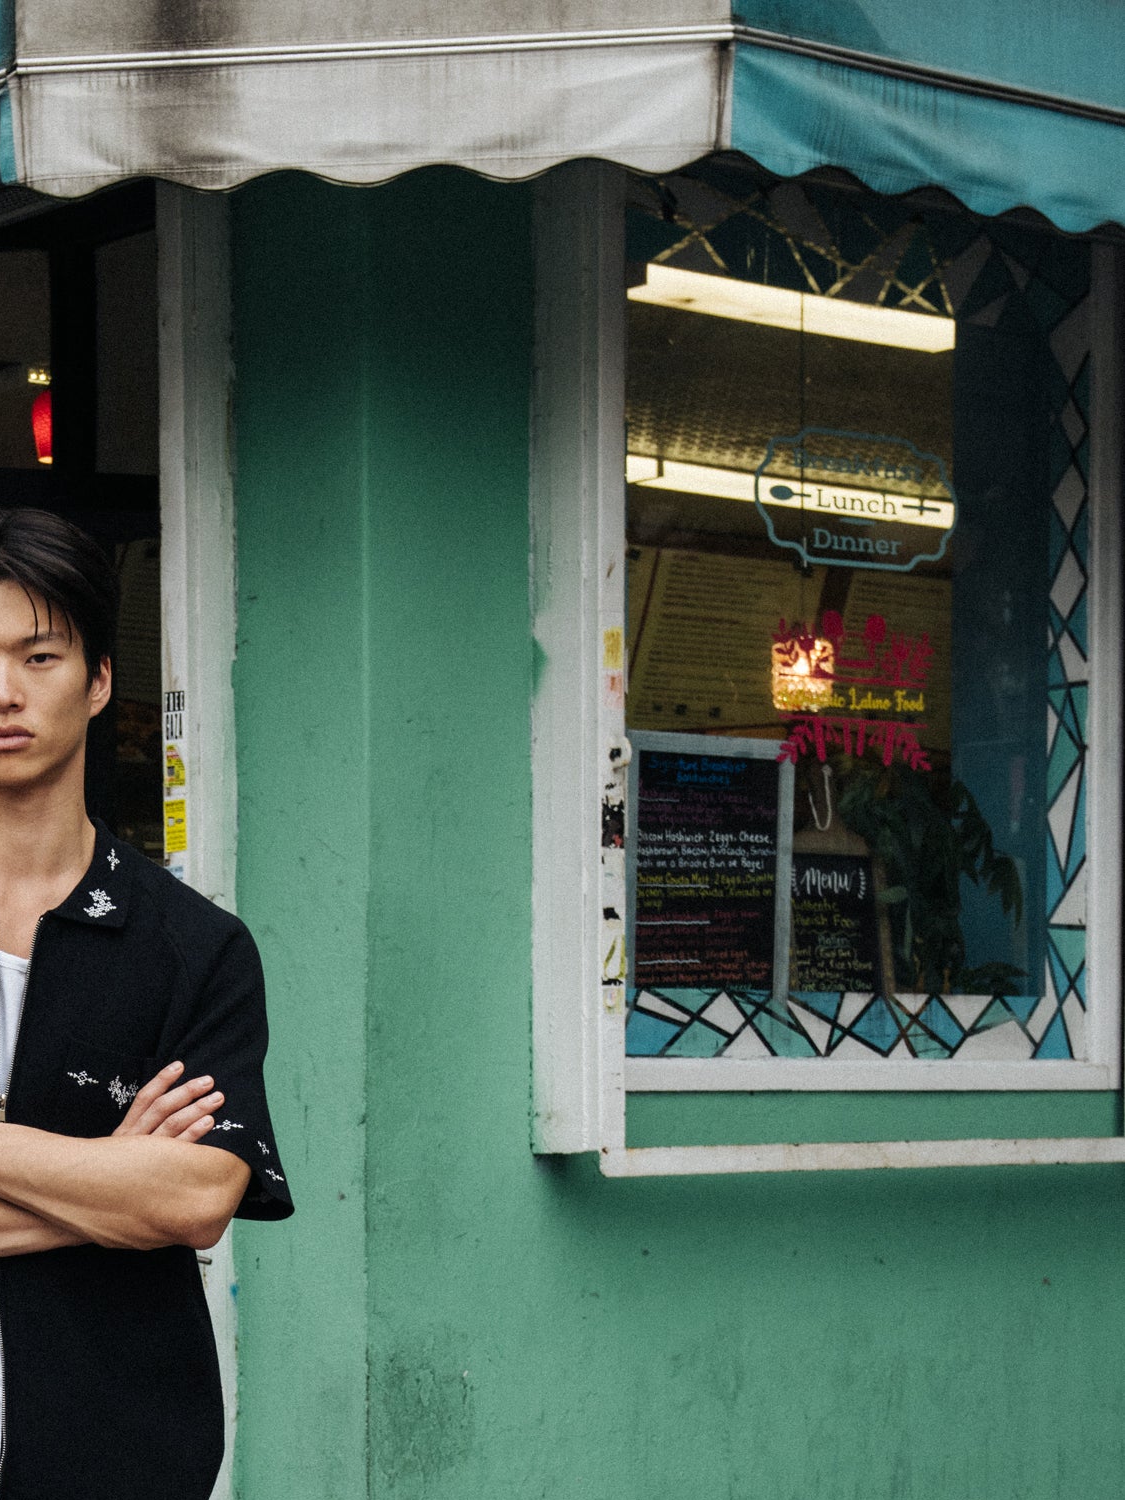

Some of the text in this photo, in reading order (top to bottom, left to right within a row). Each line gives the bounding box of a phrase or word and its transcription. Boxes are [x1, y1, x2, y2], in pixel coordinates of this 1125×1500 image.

[817, 488, 897, 515] Lunch
[813, 528, 902, 555] Dinner
[849, 686, 925, 712] Latino Food
[800, 867, 857, 897] Menu
